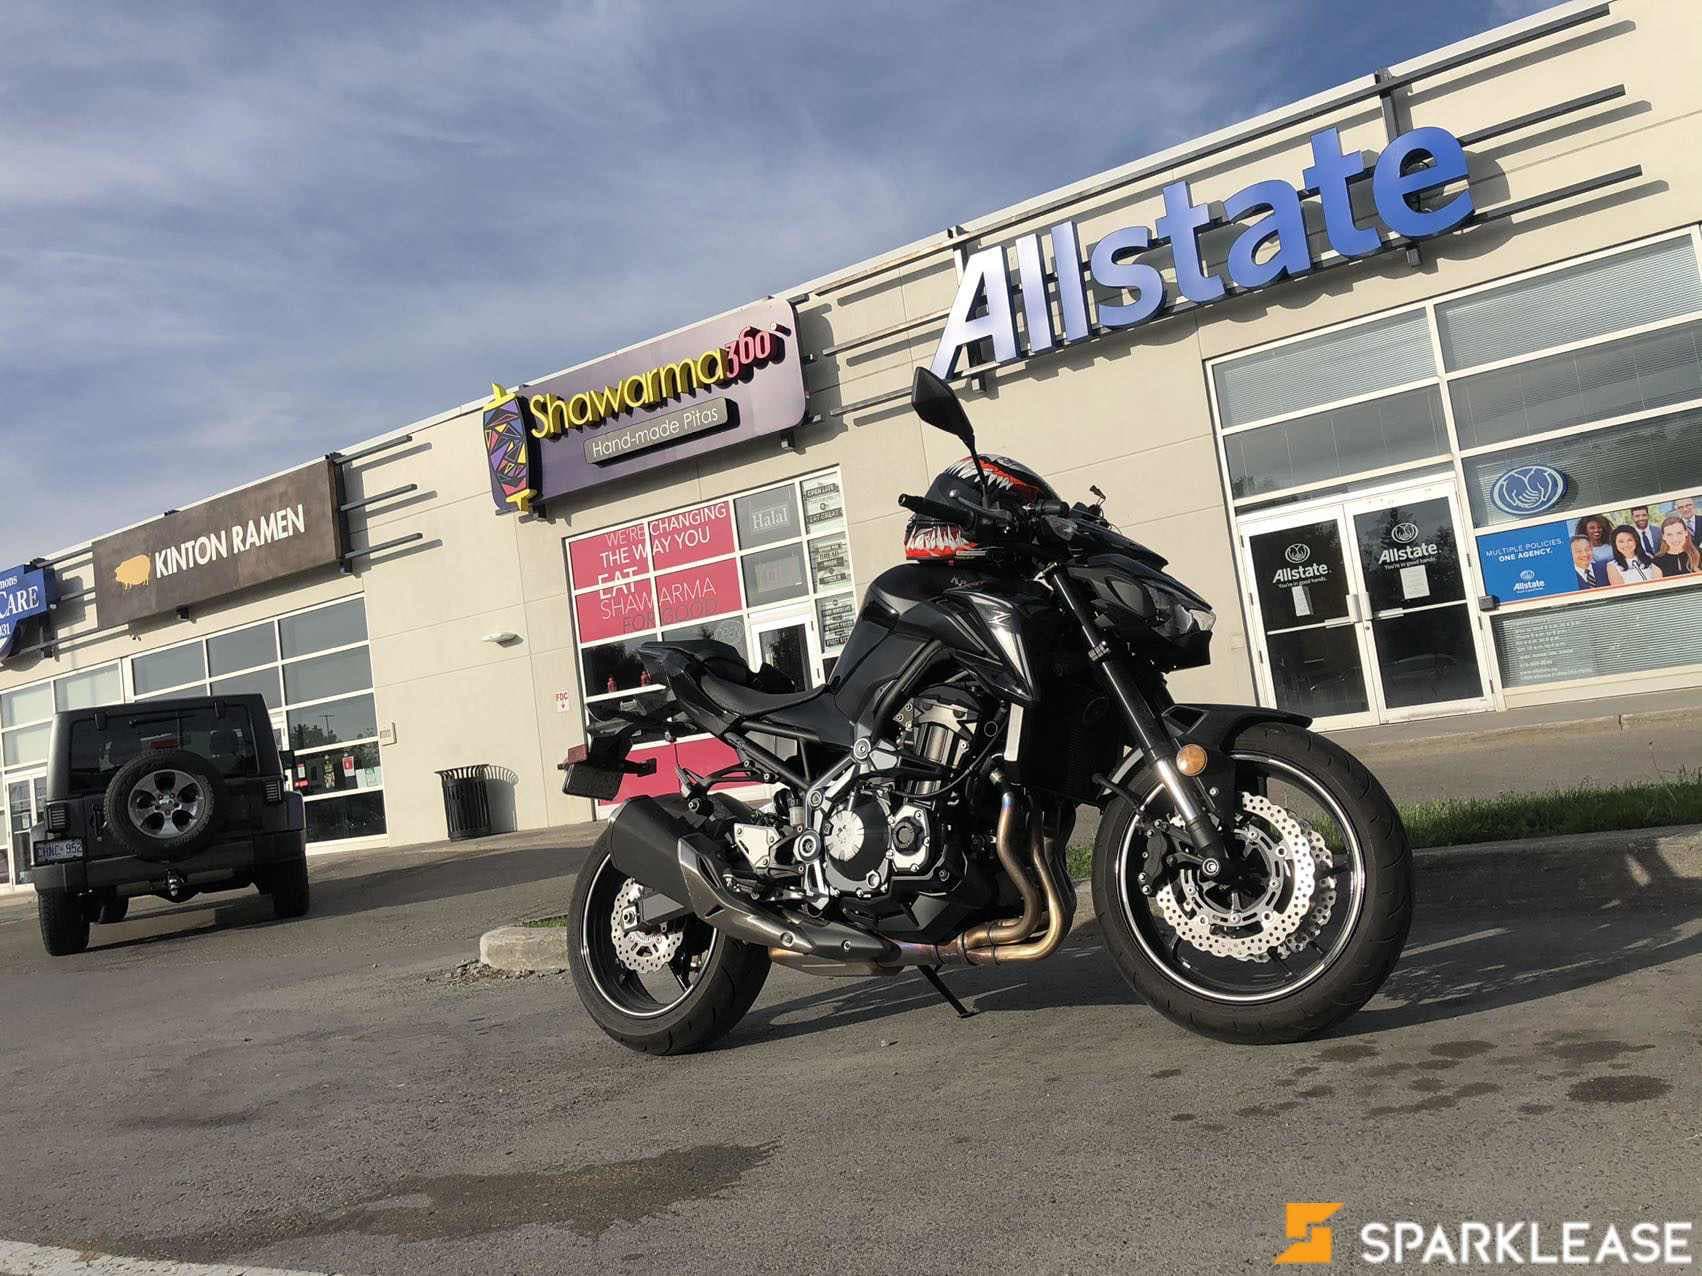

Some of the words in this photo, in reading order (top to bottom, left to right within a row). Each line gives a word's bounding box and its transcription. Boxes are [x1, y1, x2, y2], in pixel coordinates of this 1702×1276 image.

[930, 127, 1475, 379] Allstate
[529, 348, 725, 439] Shawarma
[591, 419, 680, 458] Hand-made
[682, 405, 719, 433] Pitas
[606, 525, 646, 547] WE'RE
[649, 503, 727, 535] CHANGING
[752, 508, 789, 529] Halal
[154, 530, 228, 579] KINTON
[232, 504, 305, 554] RAMEN
[600, 547, 630, 568] THE
[632, 536, 671, 560] WAY
[675, 526, 710, 550] YOU
[1486, 544, 1523, 557] MULTIPLE
[1498, 554, 1516, 562] ONE
[598, 567, 638, 599] EAT
[600, 577, 716, 620] SHAWARMA
[1513, 580, 1545, 591] Allstate
